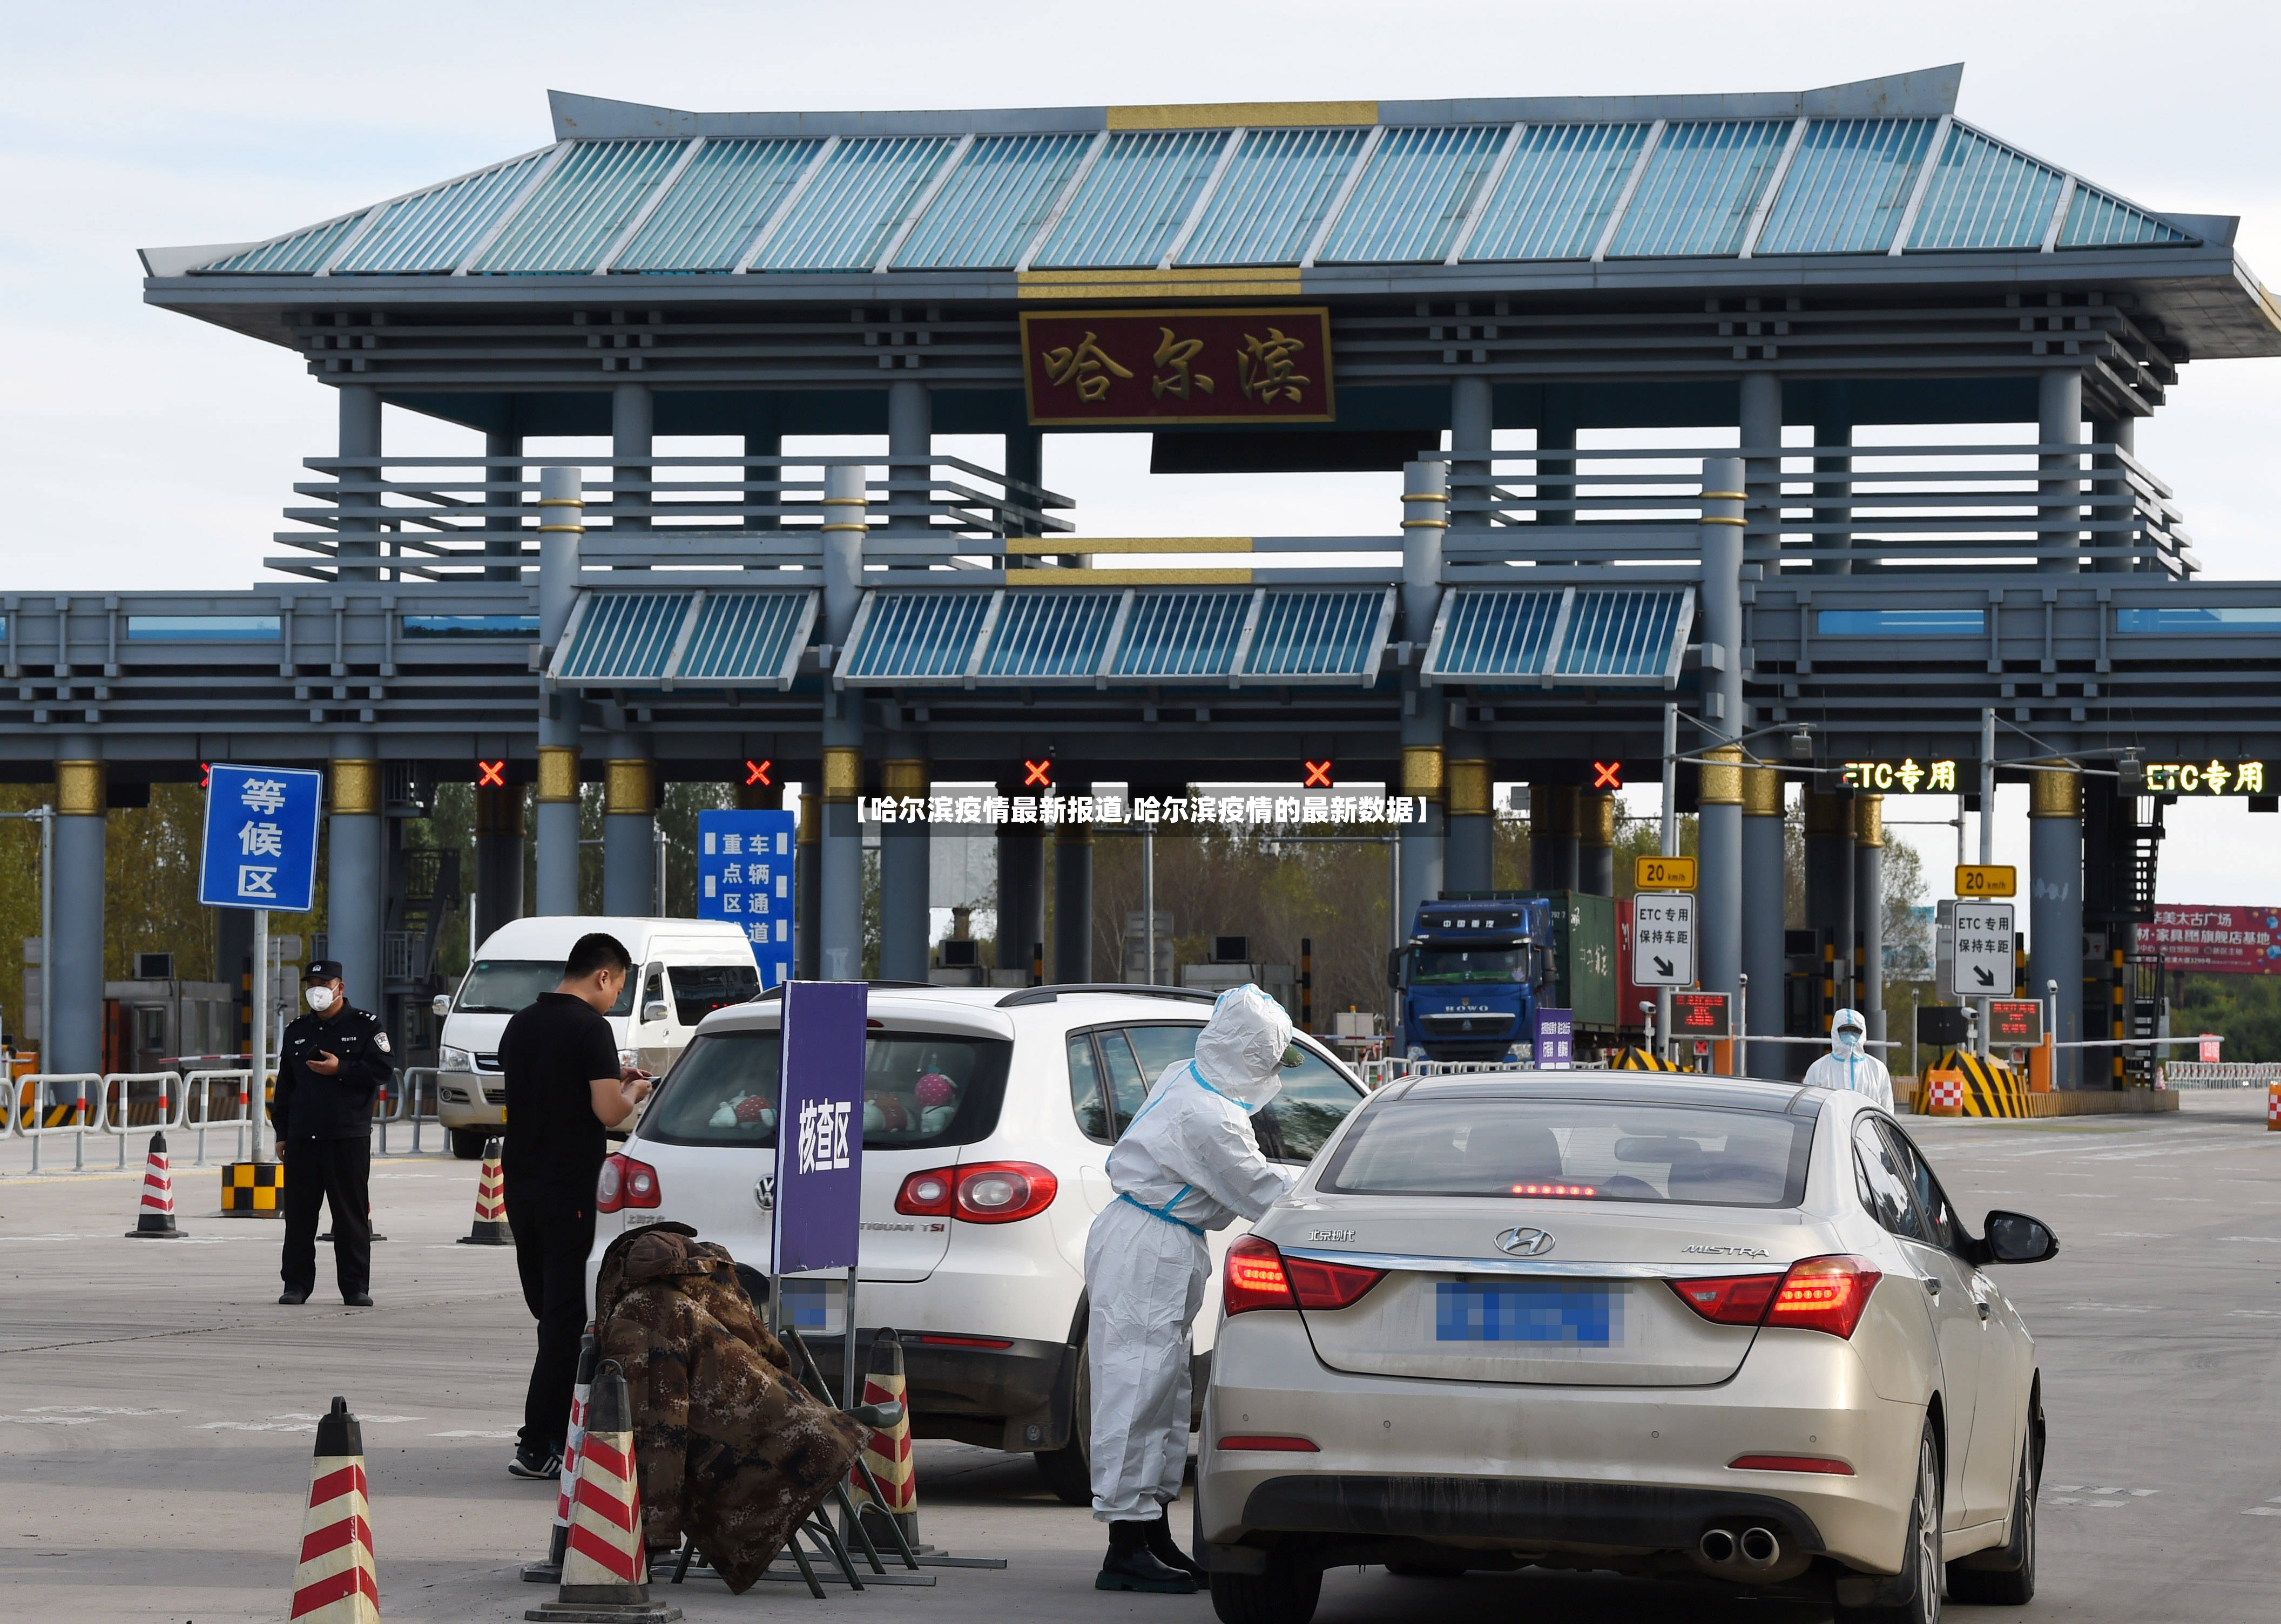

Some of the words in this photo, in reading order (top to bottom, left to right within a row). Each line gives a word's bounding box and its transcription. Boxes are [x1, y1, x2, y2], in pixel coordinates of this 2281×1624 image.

[1042, 327, 1311, 404] 哈尔滨
[238, 778, 286, 898] 等候区
[723, 834, 743, 926] 重点区
[1647, 865, 1664, 881] 20
[1668, 873, 1685, 882] km/h
[1966, 873, 1983, 889] 20
[1987, 882, 2006, 890] km/h
[748, 834, 770, 944] 车辆通道
[1640, 909, 1661, 921] ETC
[1665, 908, 1688, 922] 专用
[1443, 919, 1495, 928] 中国重汽
[1959, 918, 1981, 930] ETC
[1985, 917, 2009, 931] 专用
[1639, 930, 1688, 944] 保持车距
[1959, 939, 2009, 953] 保持车距
[798, 1098, 851, 1175] 核查区
[860, 1221, 915, 1231] TIGUAN
[921, 1222, 945, 1232] TSI
[1308, 1229, 1355, 1242] 北京现代
[1682, 1244, 1770, 1257] MISTRA
